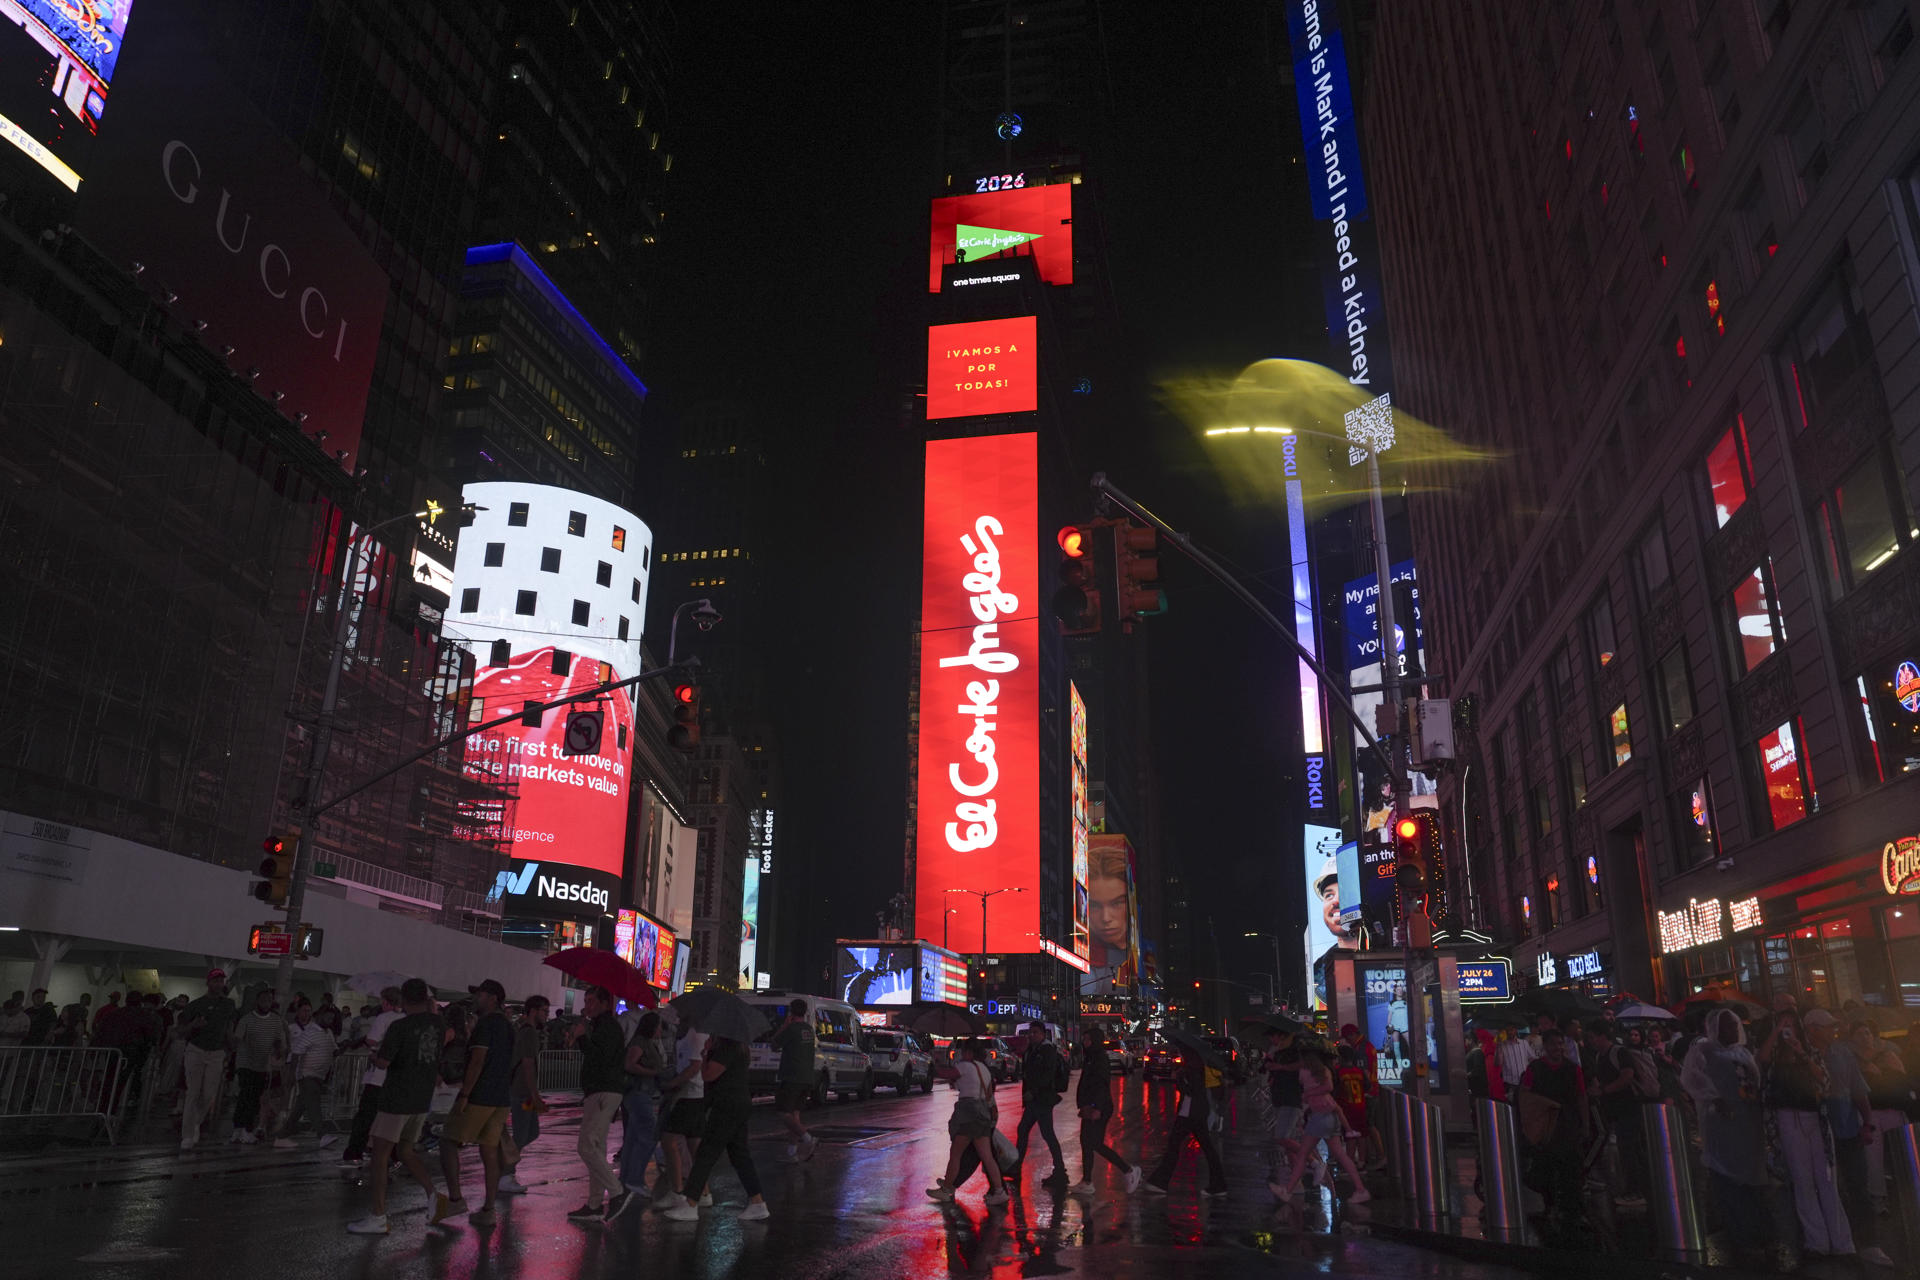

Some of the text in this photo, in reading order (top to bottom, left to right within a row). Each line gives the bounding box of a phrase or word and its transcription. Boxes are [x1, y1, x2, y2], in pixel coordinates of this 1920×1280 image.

[1311, 47, 1328, 75] is
[1314, 71, 1338, 141] Mark
[1323, 139, 1346, 190] and
[976, 172, 1025, 193] 2026
[1330, 188, 1348, 202] I
[162, 139, 348, 362] GUCCI
[1331, 203, 1358, 272] need
[953, 273, 1020, 287] one times square
[1341, 273, 1356, 293] a
[947, 344, 1017, 359] ¡VAMOS A
[1344, 291, 1370, 386] kidney
[968, 363, 996, 373] POR
[955, 379, 1008, 391] TODAS!
[1345, 590, 1364, 605] My
[939, 515, 1020, 853] El Corte Inglés
[467, 734, 500, 753] the
[505, 736, 546, 758] first
[574, 750, 612, 771] move
[612, 762, 625, 778] on
[508, 762, 585, 787] markets
[587, 774, 619, 797] value
[760, 848, 772, 874] Foot
[537, 875, 609, 912] Nasdaq
[1461, 969, 1493, 978] JULY 26
[1537, 951, 1557, 987] Lids
[1567, 951, 1603, 979] TACO BELL
[1465, 978, 1484, 986] 2PM
[987, 1000, 1016, 1015] DEPT
